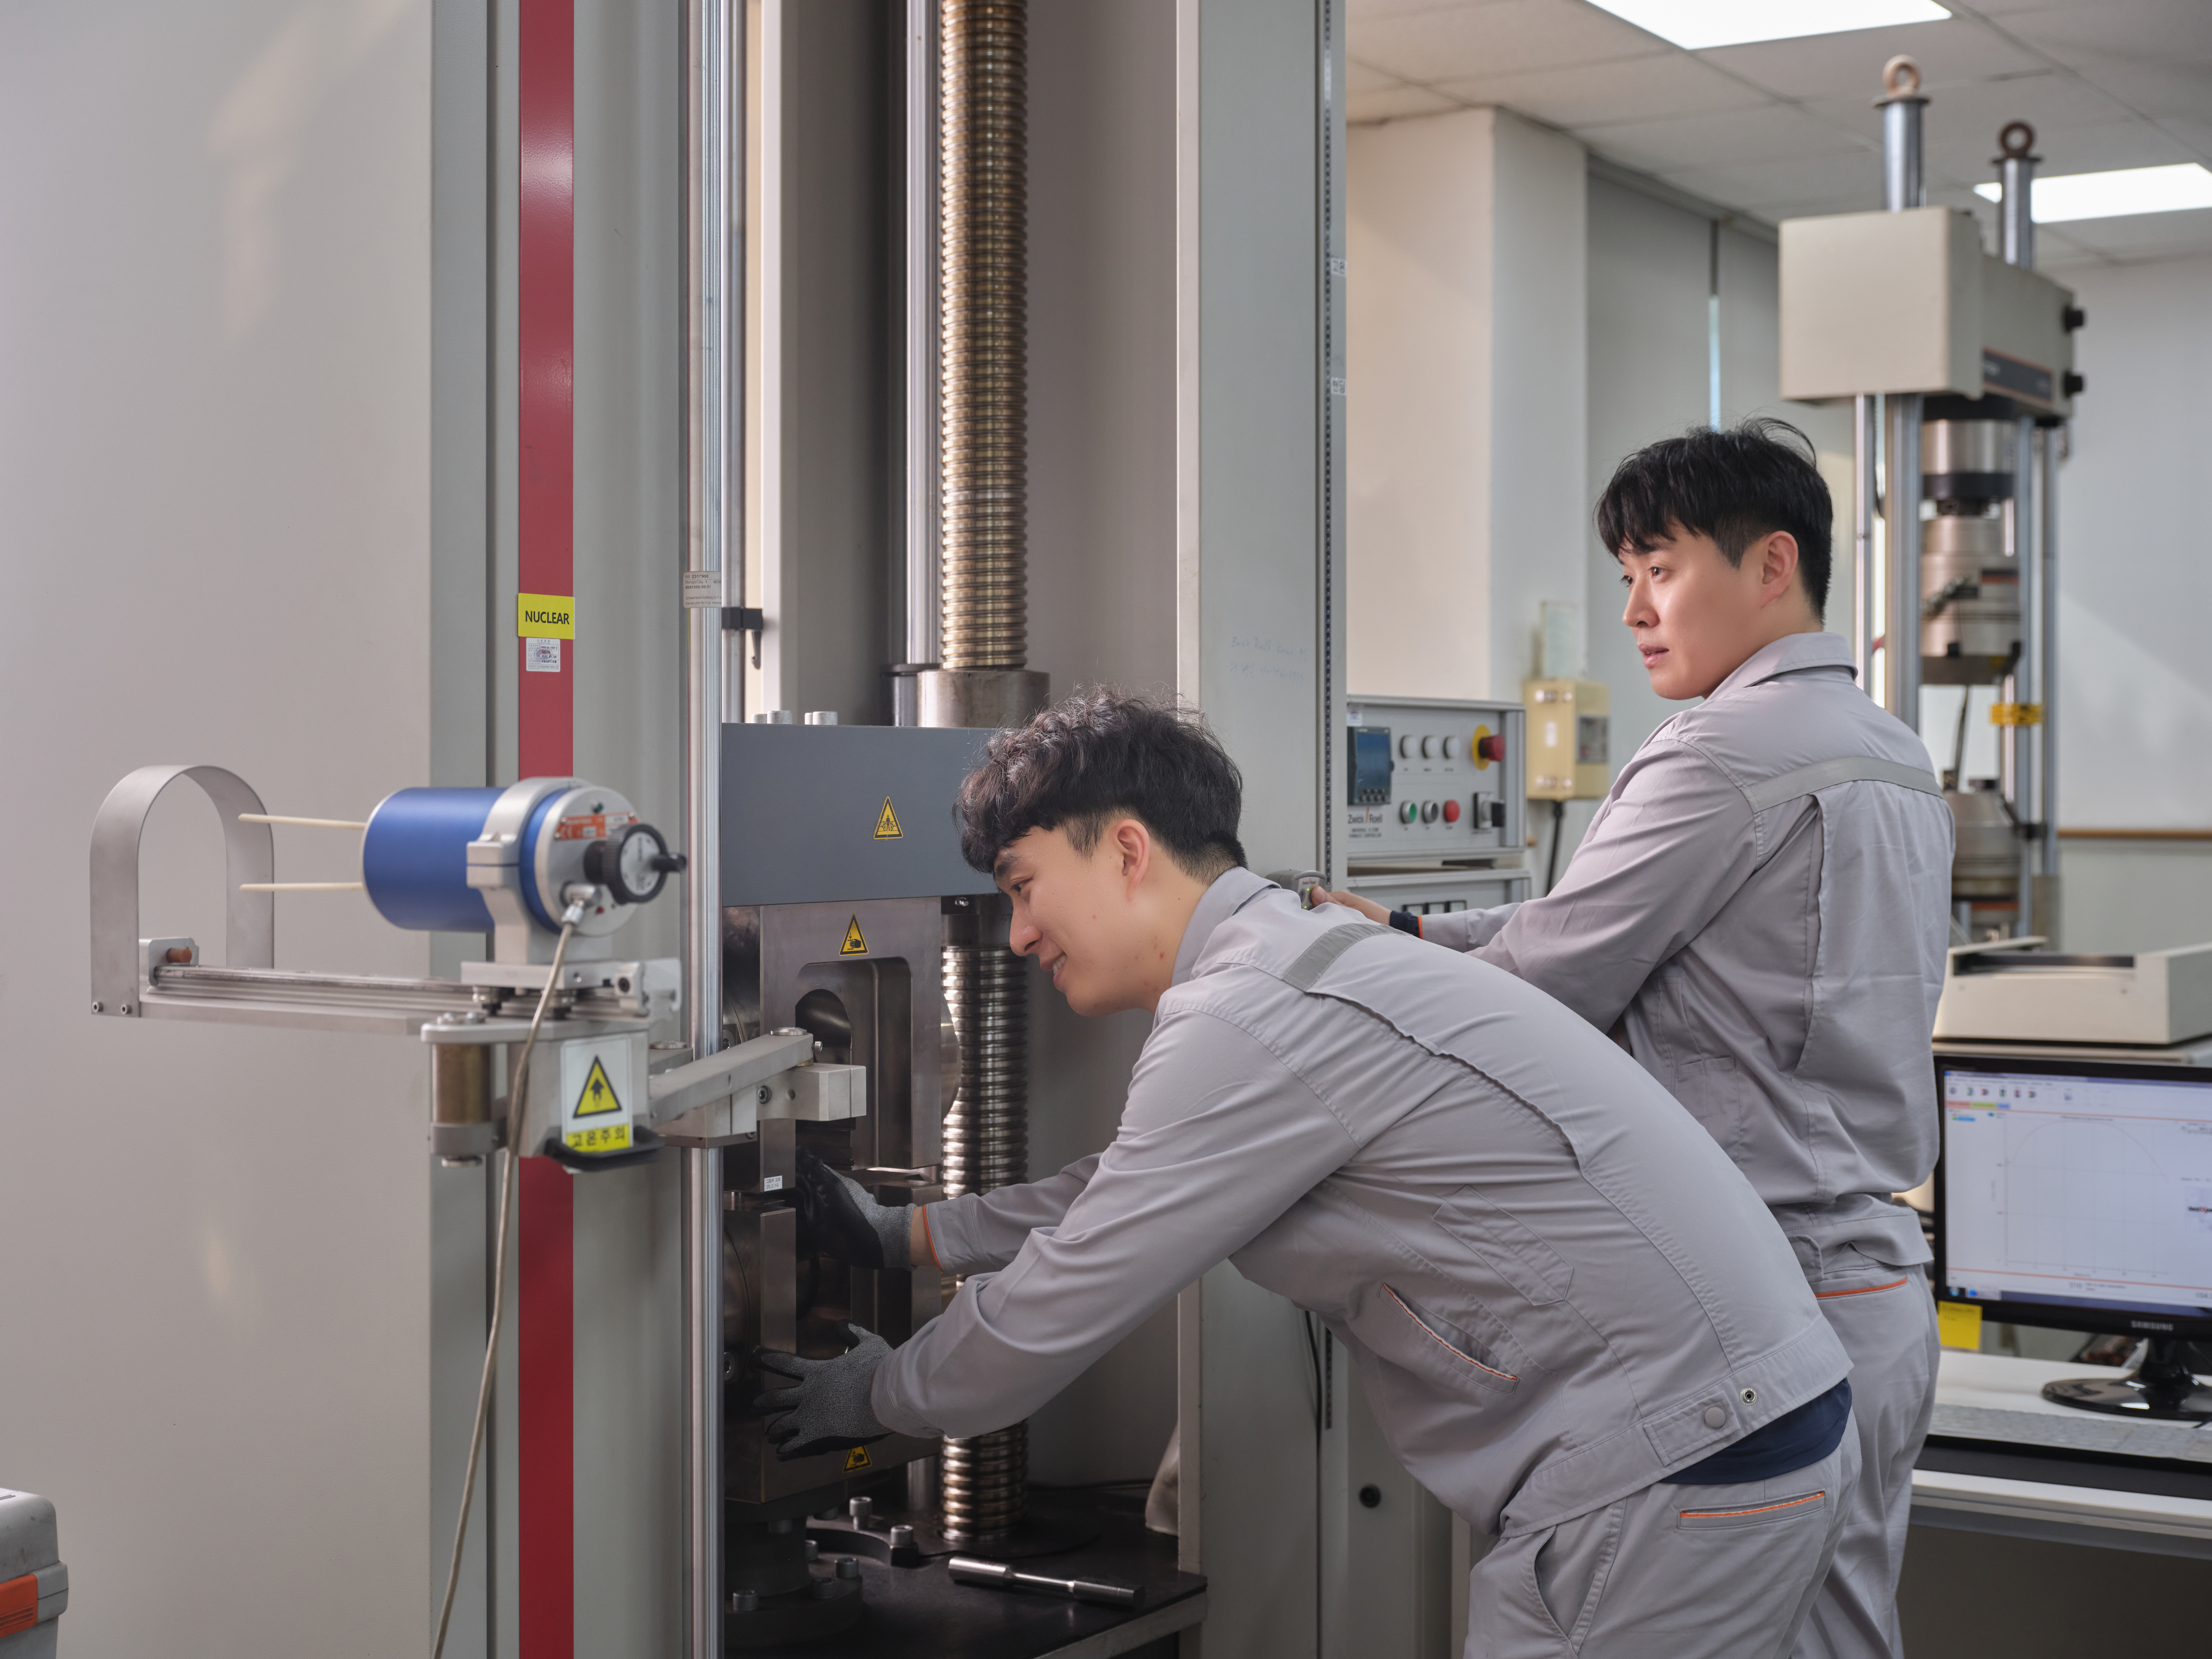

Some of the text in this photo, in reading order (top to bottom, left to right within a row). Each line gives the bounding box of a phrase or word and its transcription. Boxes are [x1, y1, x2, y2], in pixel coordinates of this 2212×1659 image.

[525, 610, 569, 625] NUCLEAR
[571, 1125, 625, 1148] 고온주의
[2131, 1320, 2174, 1331] SAMSUNG
